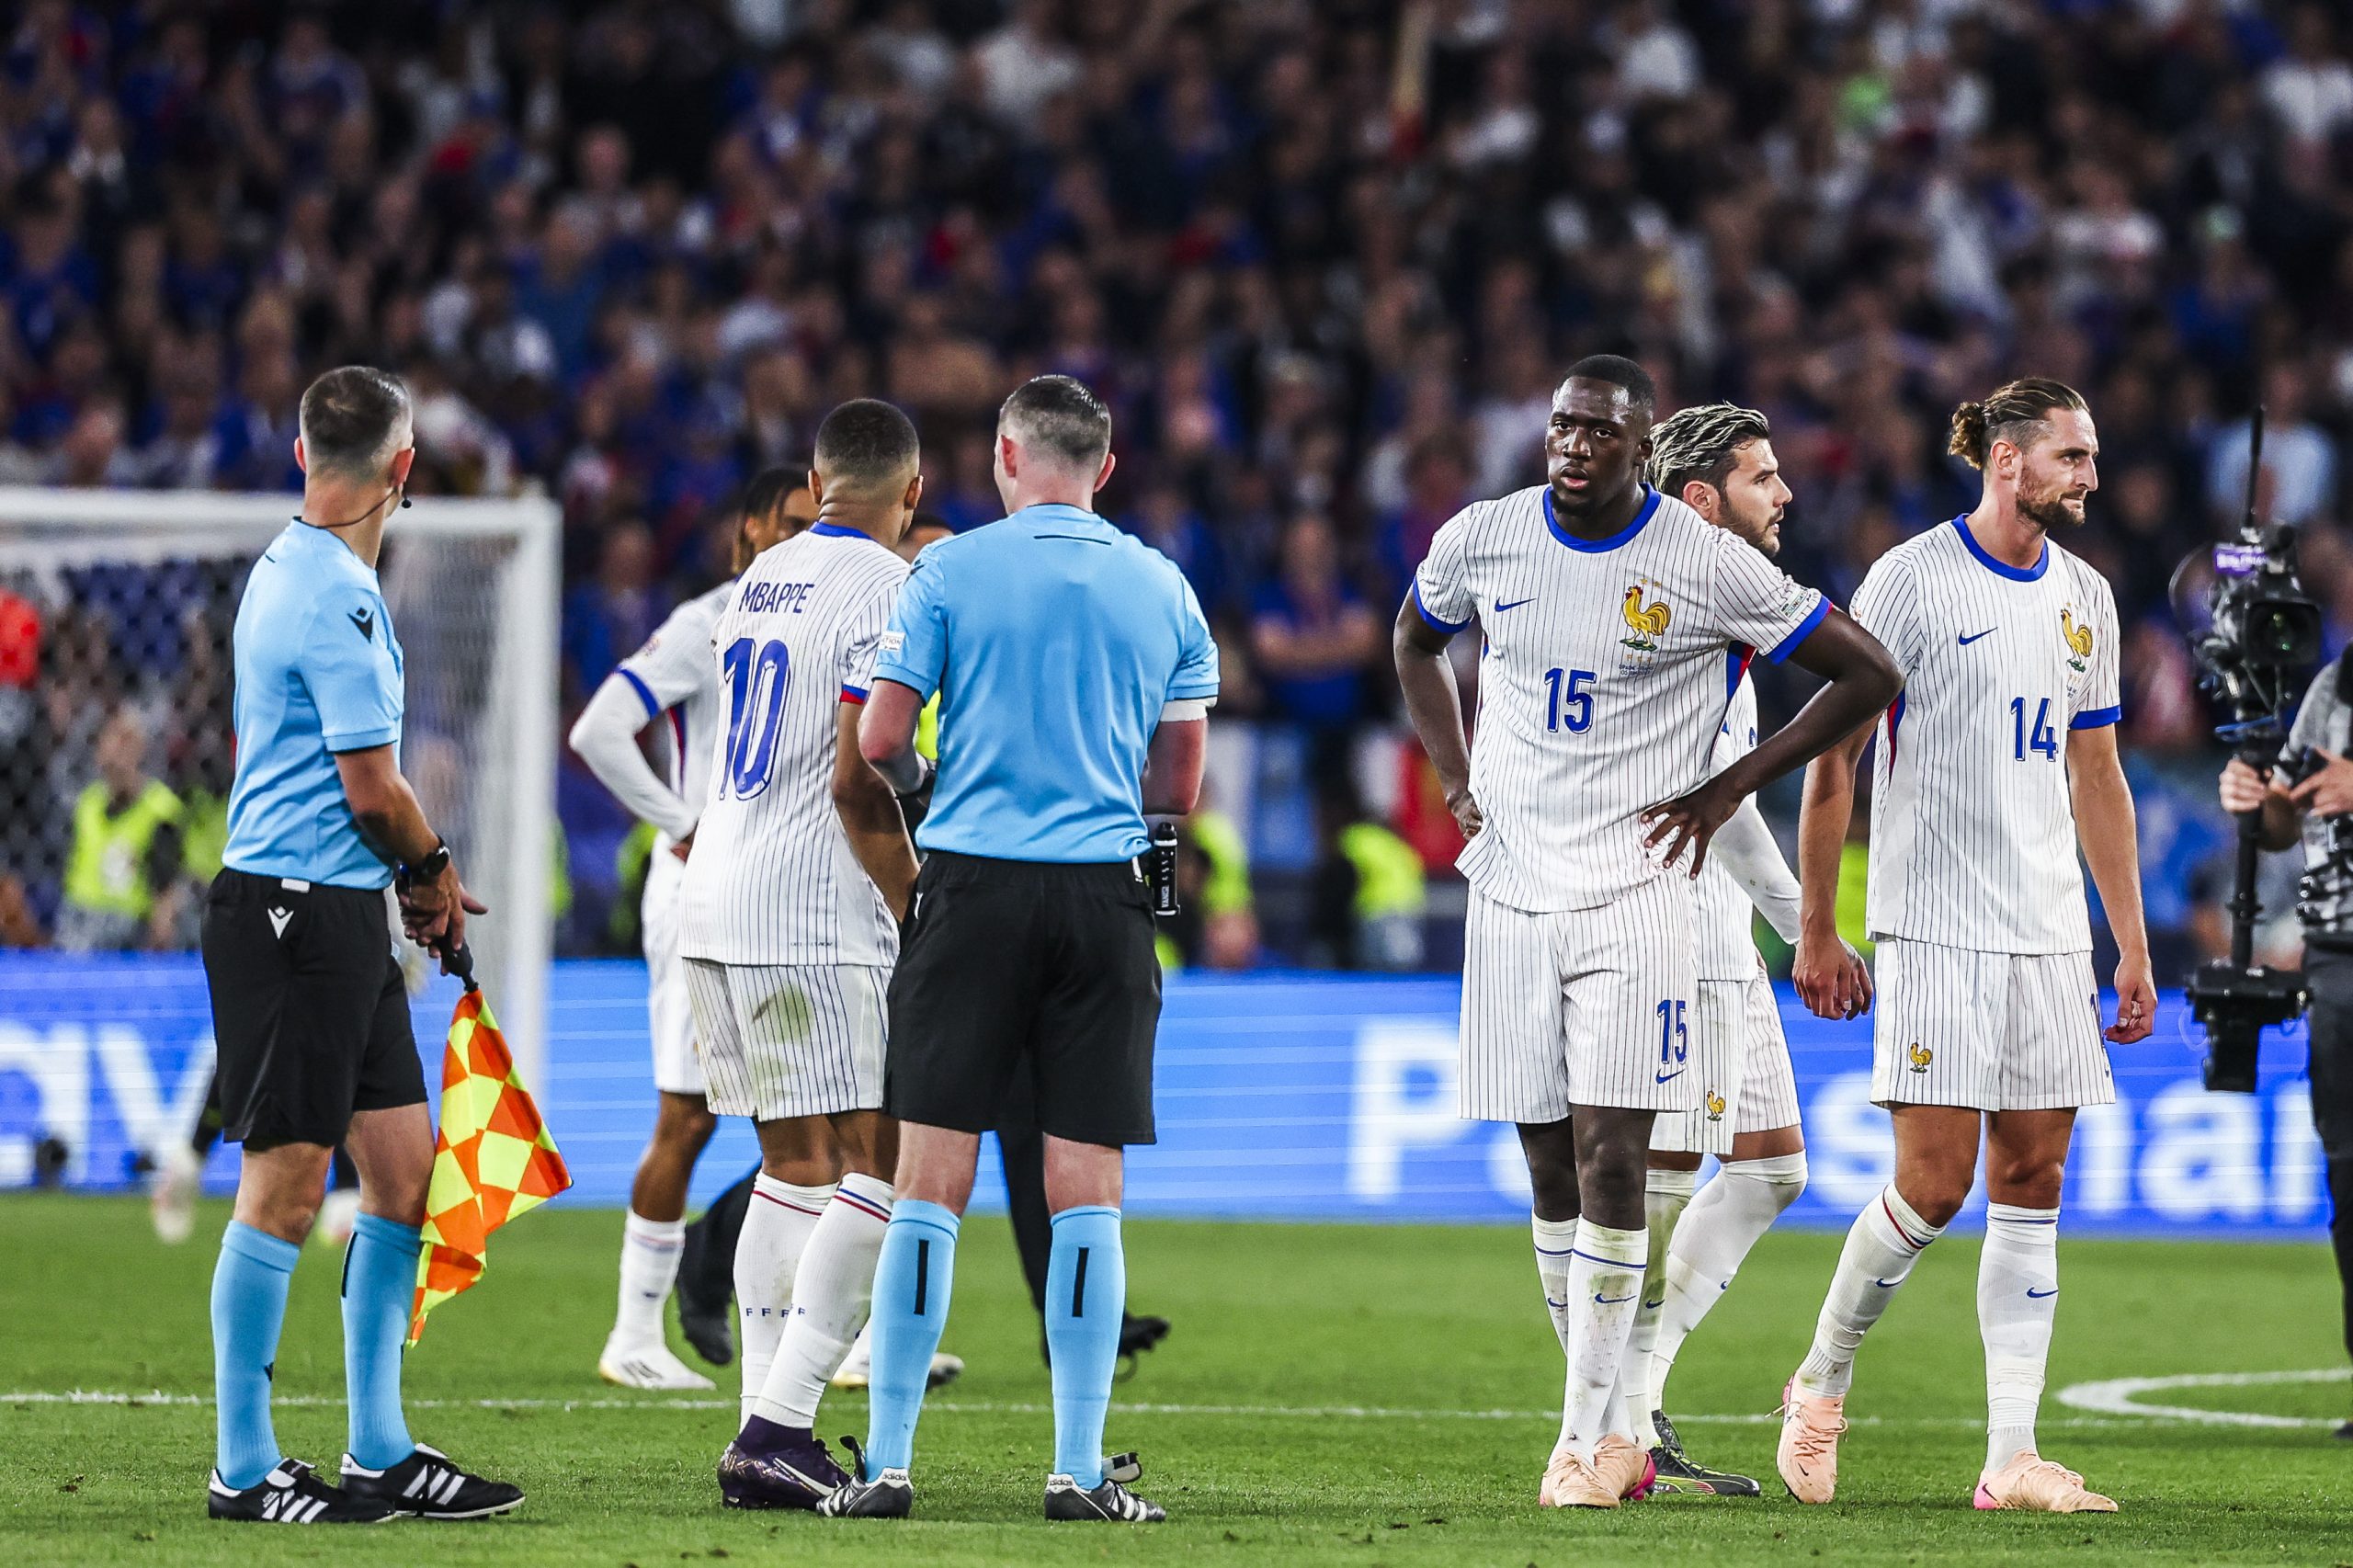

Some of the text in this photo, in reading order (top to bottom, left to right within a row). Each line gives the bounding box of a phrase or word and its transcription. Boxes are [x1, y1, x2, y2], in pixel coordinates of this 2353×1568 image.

[739, 582, 814, 614] MBAPPE
[719, 637, 790, 801] 10
[1544, 667, 1597, 734] 15
[2010, 697, 2059, 762] 14
[1657, 999, 1687, 1065] 15
